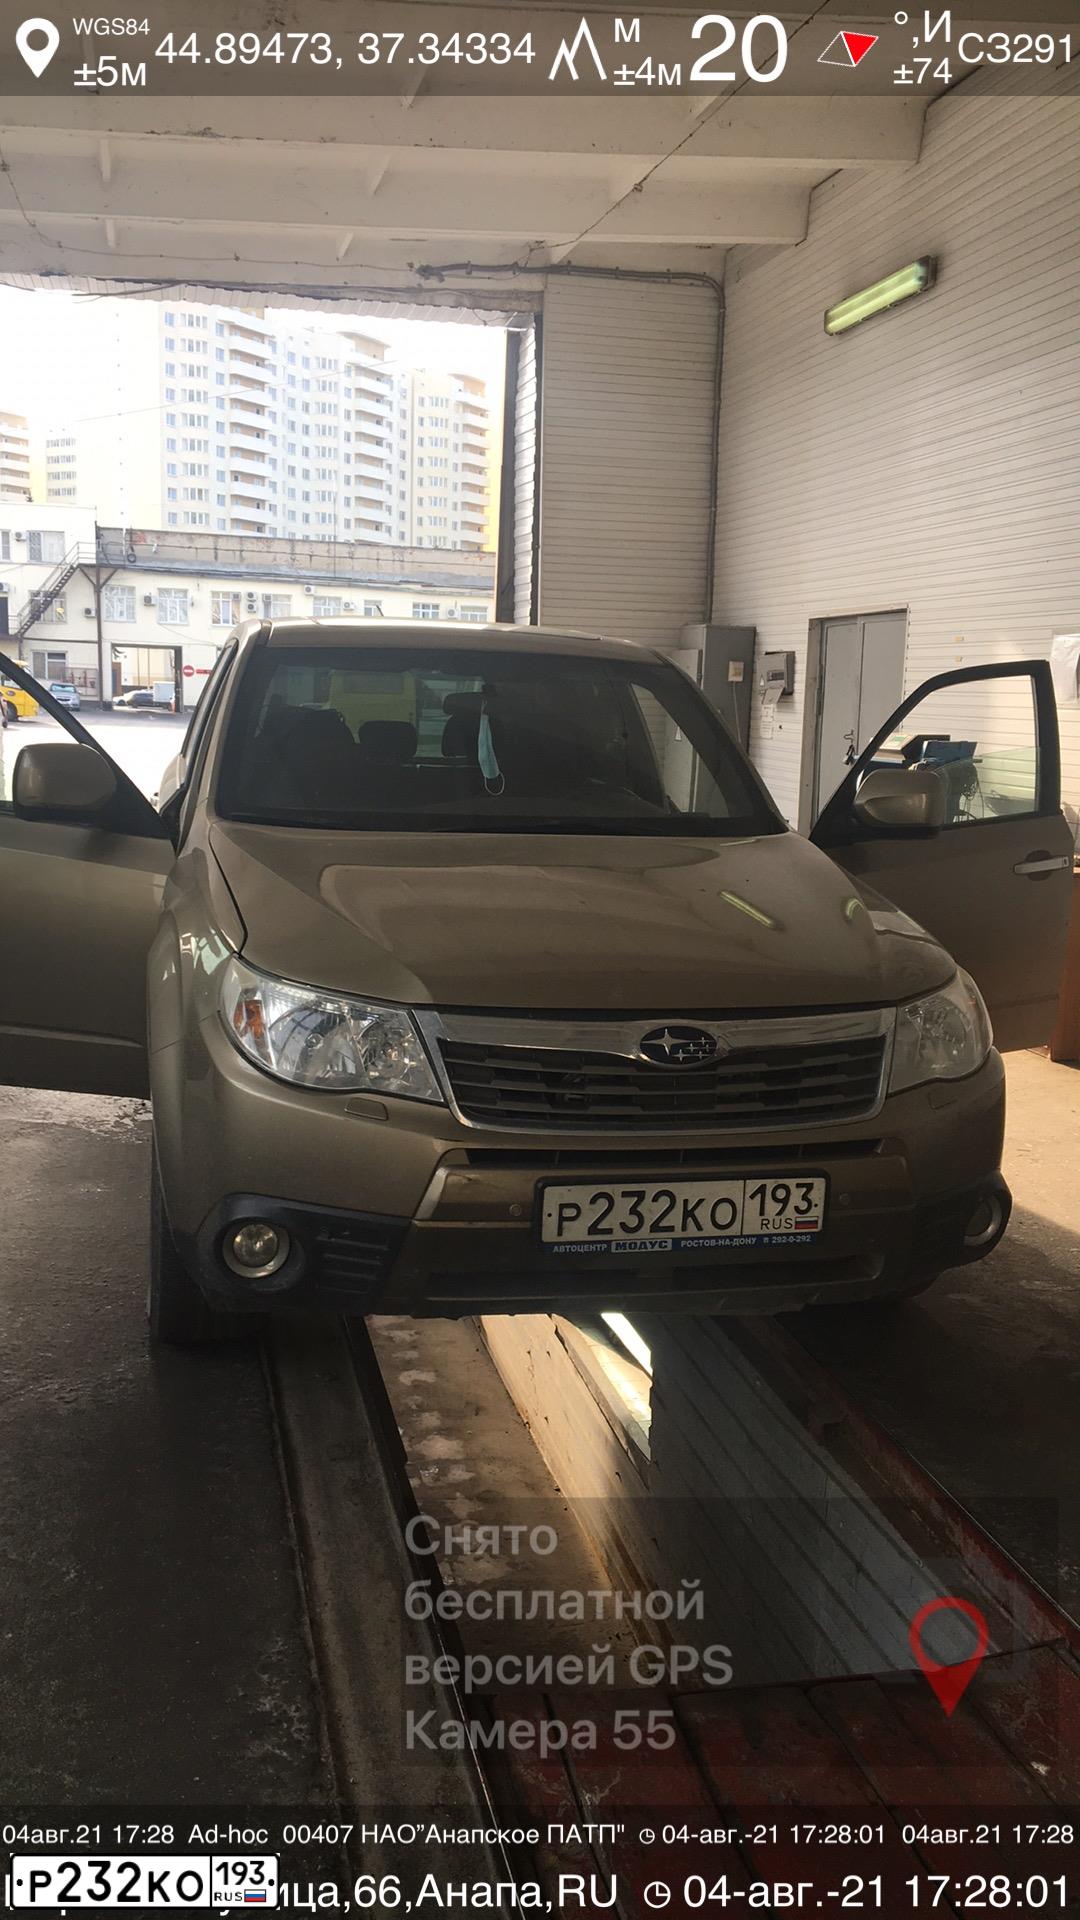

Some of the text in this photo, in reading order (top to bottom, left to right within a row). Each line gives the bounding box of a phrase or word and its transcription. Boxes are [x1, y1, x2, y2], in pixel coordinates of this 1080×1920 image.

[557, 1183, 815, 1237] Р232КО 193
[760, 1216, 793, 1231] RUS
[552, 1243, 608, 1253] АВТОЦЕНТР
[614, 1240, 669, 1252] МОДУС
[680, 1237, 757, 1248] РОСТОВ-НА-ДОНУ
